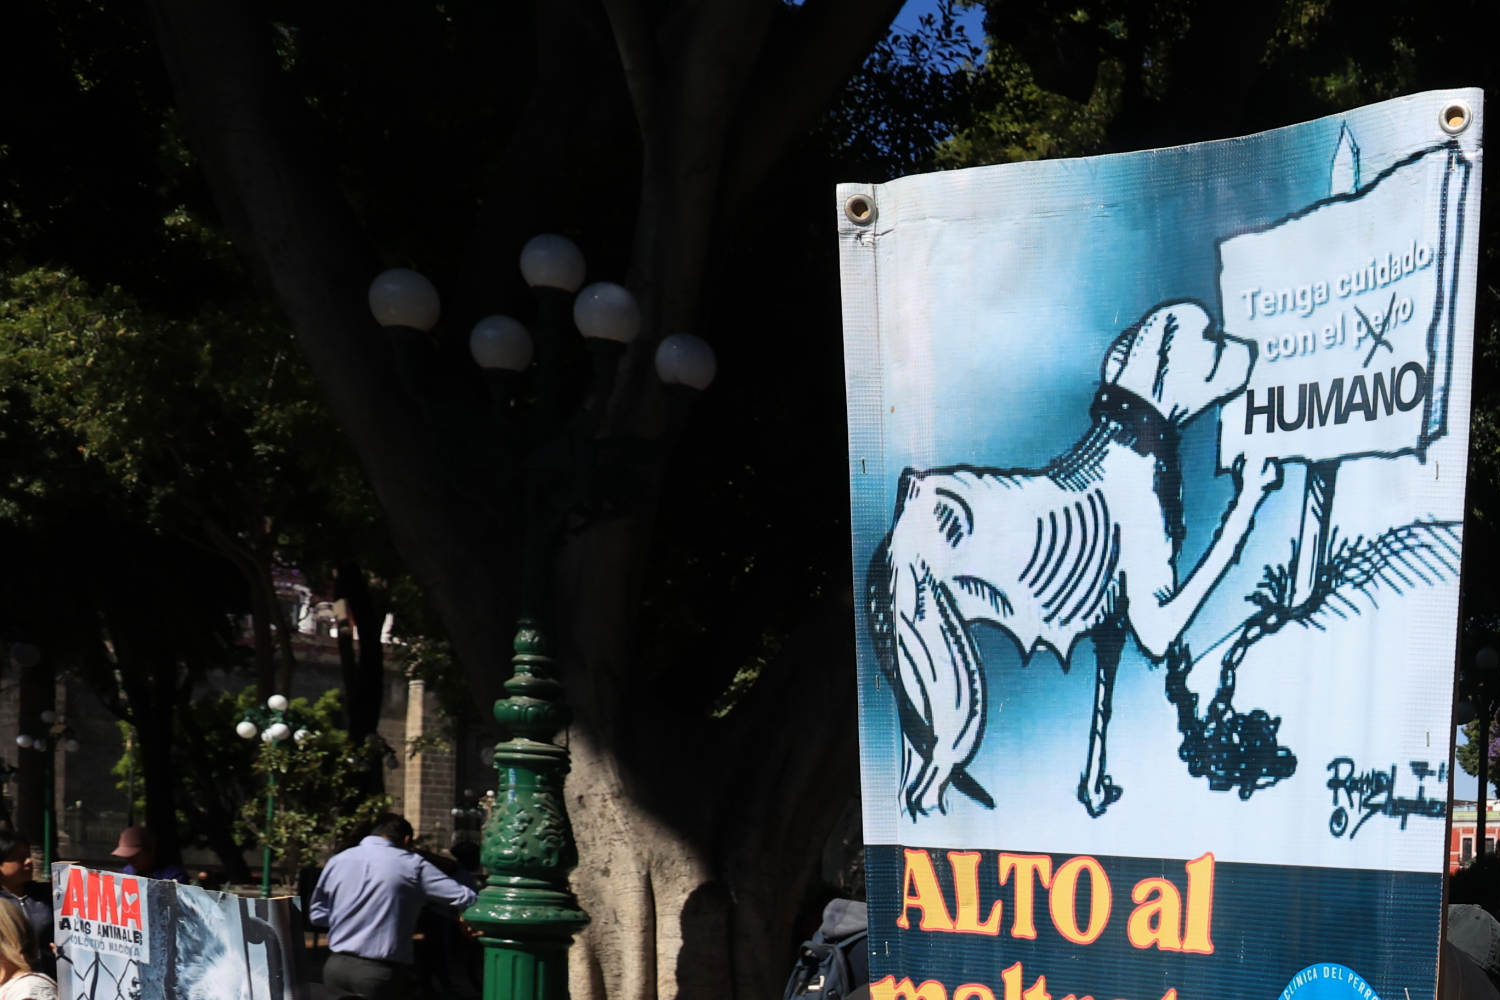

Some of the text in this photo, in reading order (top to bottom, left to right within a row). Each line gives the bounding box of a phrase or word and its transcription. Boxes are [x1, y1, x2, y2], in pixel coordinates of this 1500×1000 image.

[1240, 239, 1434, 320] Tenga cuidado
[1263, 325, 1316, 362] con
[1322, 312, 1346, 349] el
[1244, 361, 1427, 435] HUMANO
[60, 917, 71, 930] A
[61, 868, 142, 930] AMA
[897, 849, 1215, 955] ALTO al
[1323, 966, 1343, 980] DEL
